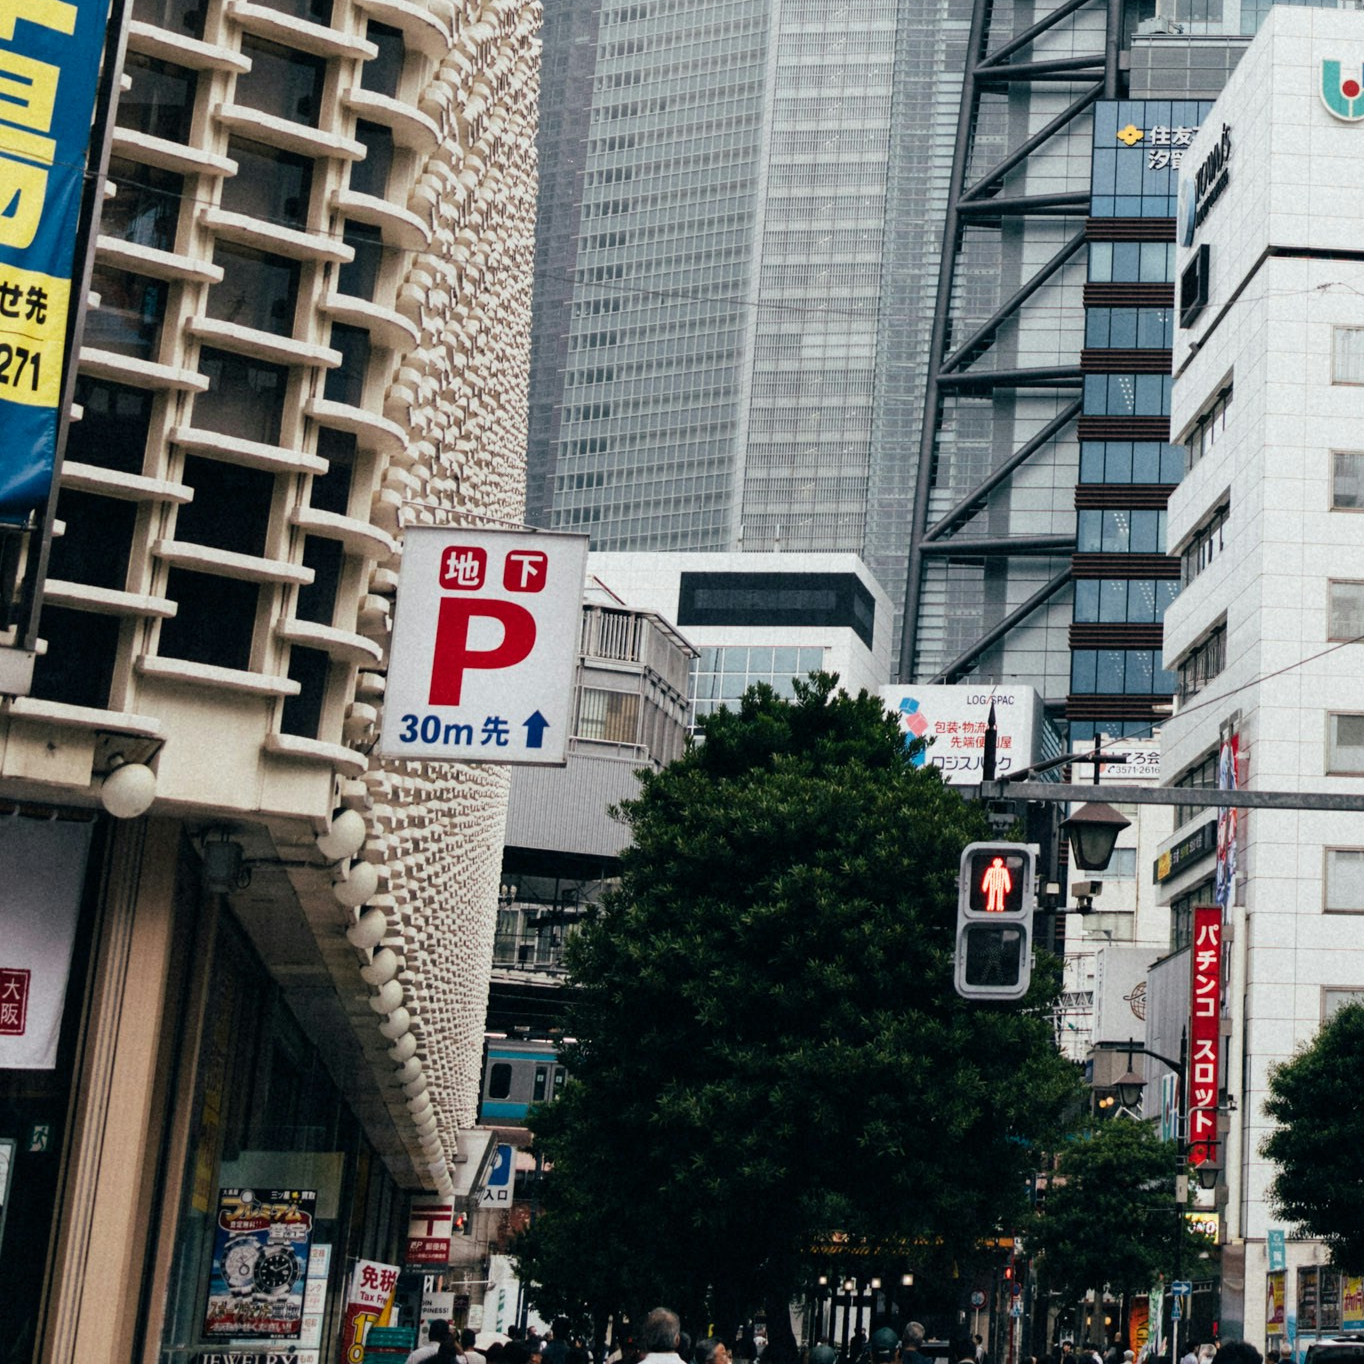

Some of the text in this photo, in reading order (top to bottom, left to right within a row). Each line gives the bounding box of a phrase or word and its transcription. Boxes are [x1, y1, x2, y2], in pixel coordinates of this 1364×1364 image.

[444, 552, 544, 588] 地下
[428, 597, 537, 707] P
[931, 756, 1012, 771] ロジスク
[1196, 924, 1220, 1017] パチンコ
[1, 977, 21, 1025] 大阪
[1194, 1039, 1216, 1134] スロット
[221, 1197, 302, 1221] プレミアム
[483, 1189, 508, 1201] 入口
[425, 1242, 447, 1251] 郵便局
[360, 1265, 397, 1294] 免税
[360, 1290, 388, 1305] Tax Fre
